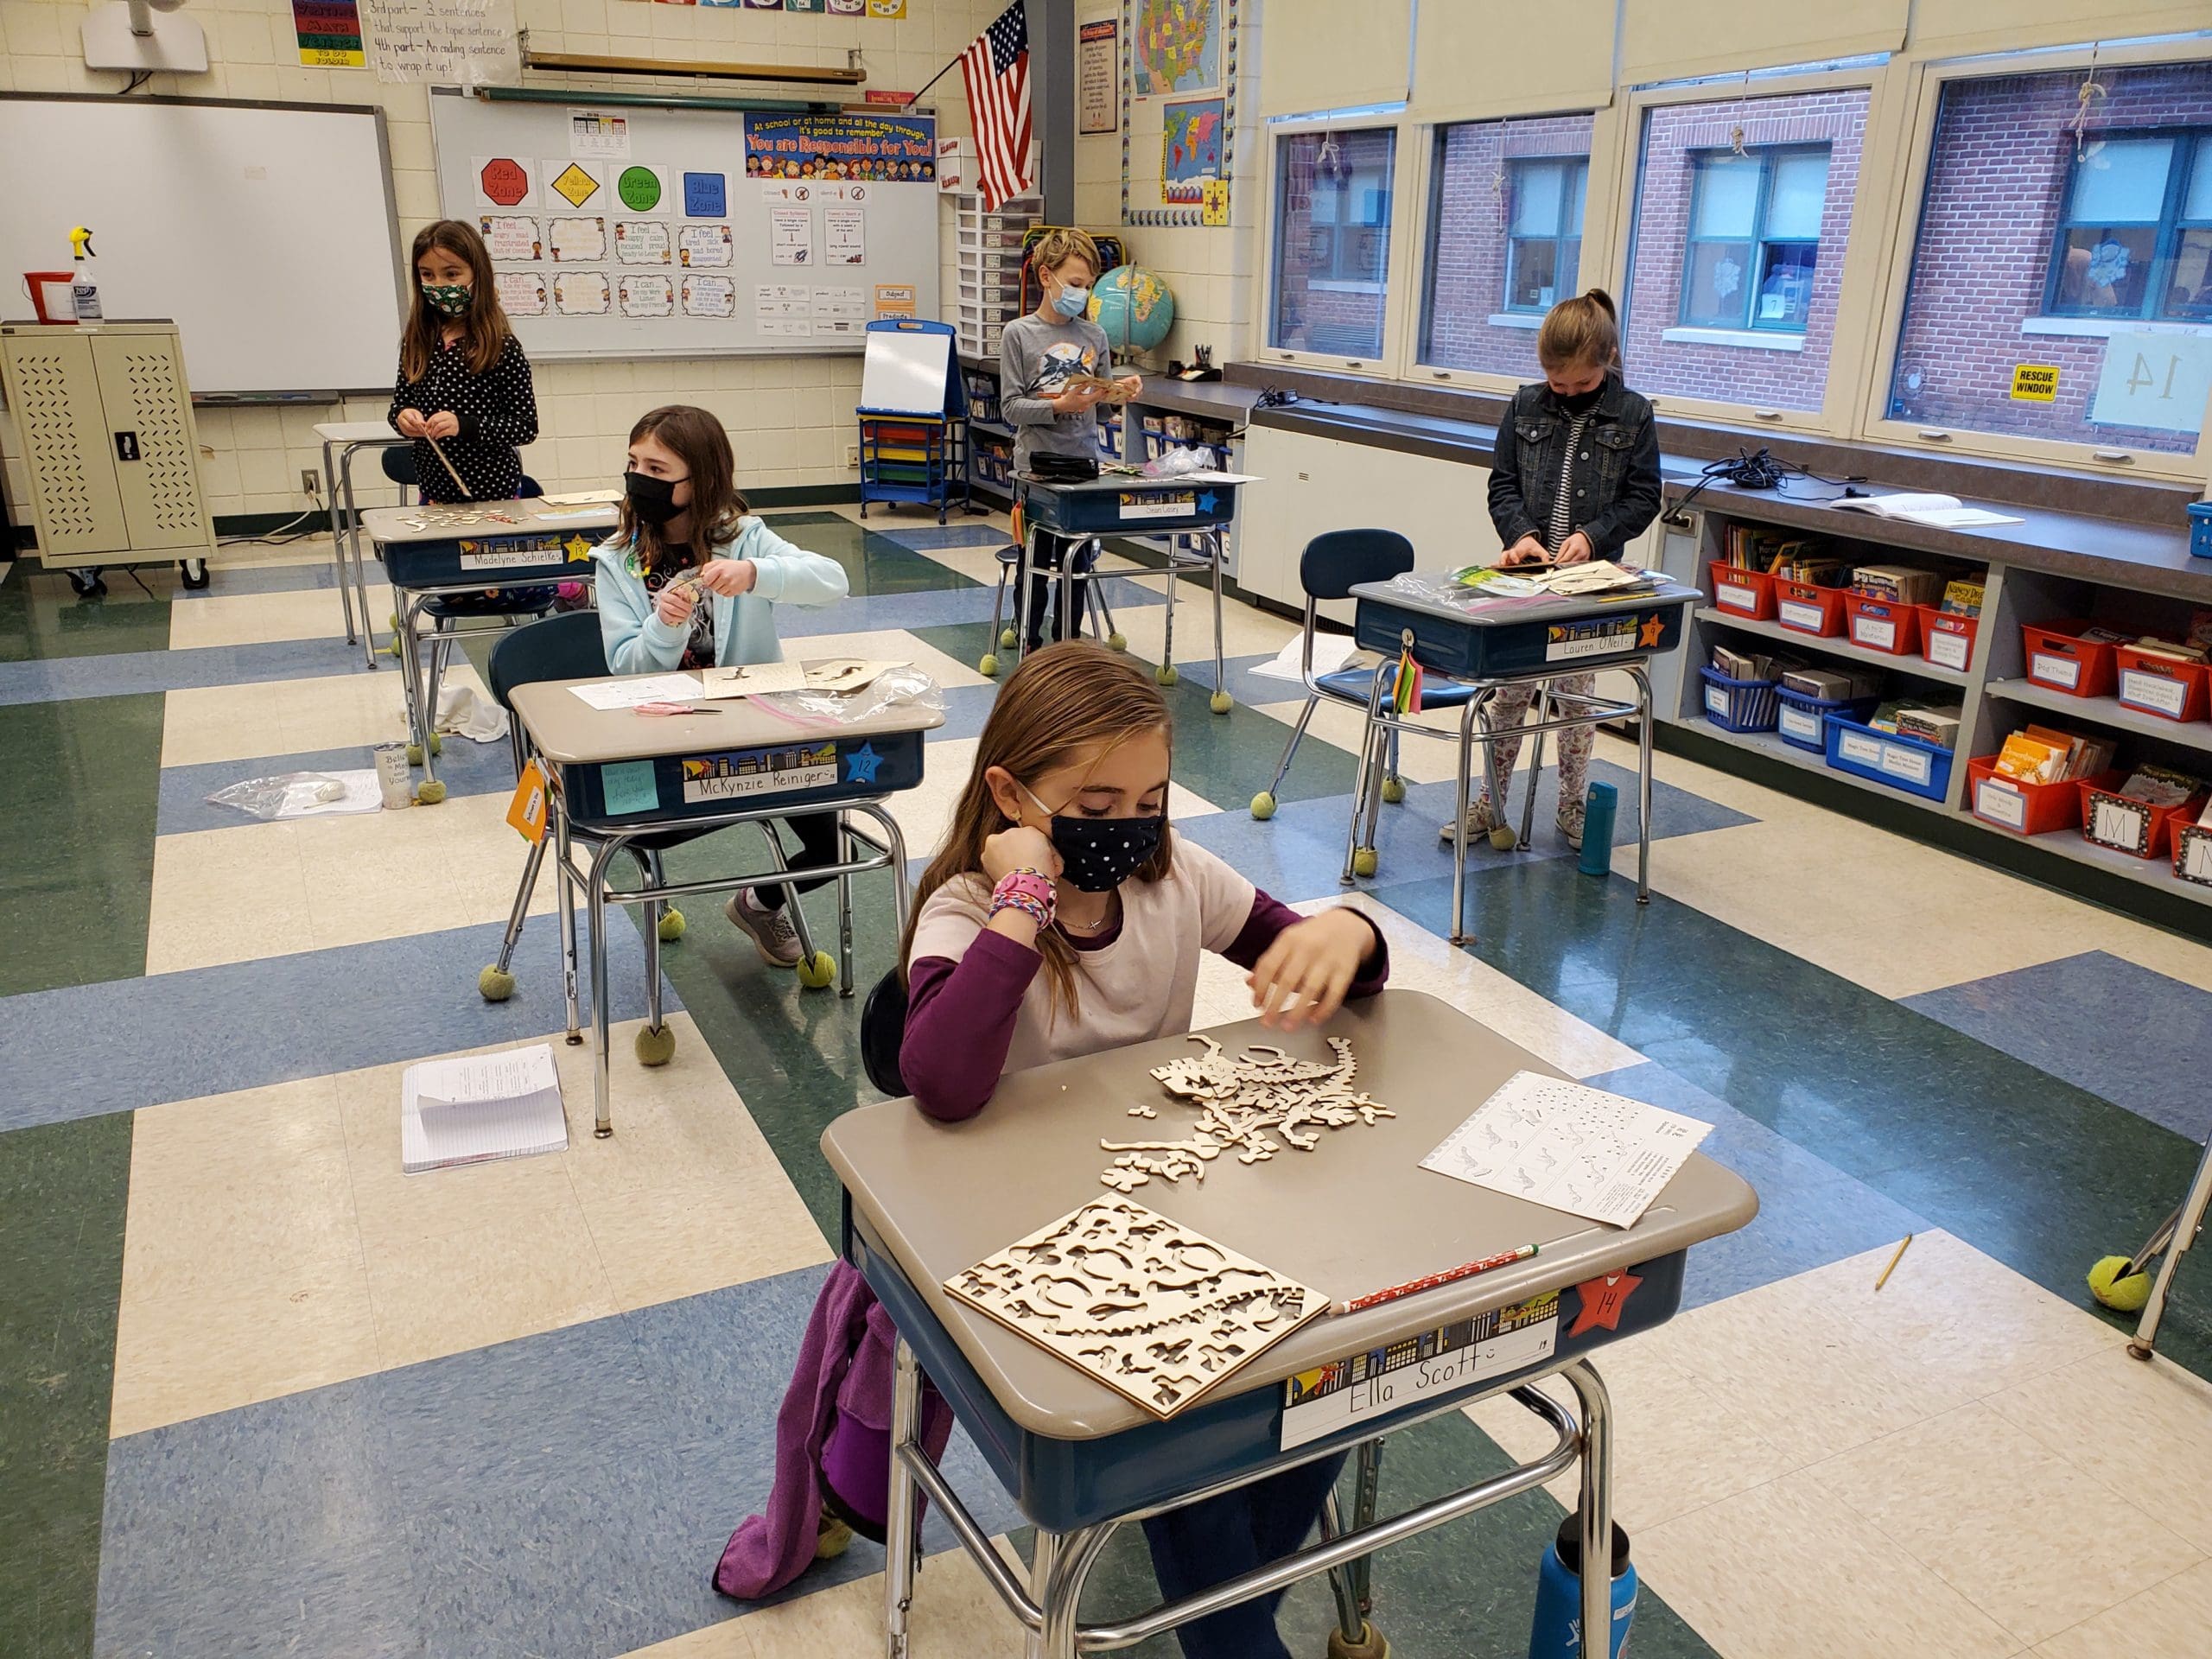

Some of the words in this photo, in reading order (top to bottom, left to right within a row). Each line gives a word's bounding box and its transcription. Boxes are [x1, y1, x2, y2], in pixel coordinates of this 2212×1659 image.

[389, 4, 410, 23] part
[439, 4, 486, 17] sentences
[374, 21, 395, 33] that
[397, 22, 425, 40] support
[445, 22, 464, 39] topic
[467, 22, 502, 35] sentence
[374, 37, 391, 53] 4th
[394, 40, 415, 56] part
[426, 39, 438, 54] An
[441, 41, 466, 59] ending
[468, 41, 505, 54] sentence
[380, 57, 393, 71] to
[397, 61, 422, 76] wrap
[425, 58, 433, 72] it
[436, 59, 453, 78] up!
[754, 123, 764, 132] At
[766, 118, 791, 129] school
[814, 117, 836, 125] home
[855, 118, 863, 126] all
[865, 119, 877, 129] the
[880, 122, 893, 133] day
[895, 124, 926, 141] through,
[799, 126, 810, 135] It's
[813, 126, 833, 137] good
[747, 134, 773, 151] You
[776, 138, 798, 152] are
[798, 136, 879, 156] Responsible
[880, 139, 901, 156] for
[903, 138, 933, 156] You!
[492, 165, 518, 181] Red
[563, 175, 592, 187] Yellow
[622, 175, 658, 189] Green
[690, 180, 719, 195] Blue
[491, 182, 523, 198] Zone
[567, 187, 590, 198] Zone
[625, 190, 657, 205] Zone
[690, 198, 721, 212] Zone
[1770, 299, 1777, 312] 7
[2019, 370, 2054, 383] RESCUE
[2016, 383, 2054, 395] WINDOW
[574, 546, 584, 556] 13
[474, 554, 517, 567] Madelyne
[1970, 588, 1985, 598] DRE
[1564, 640, 1594, 655] Lauren
[1599, 635, 1624, 648] O'Neil
[857, 760, 871, 773] 12
[699, 777, 764, 798] McKynzie
[772, 770, 823, 787] Reiniger
[2104, 809, 2126, 842] M
[1599, 1291, 1617, 1316] 14
[1350, 1374, 1394, 1414] Ella
[1415, 1344, 1478, 1389] Scott
